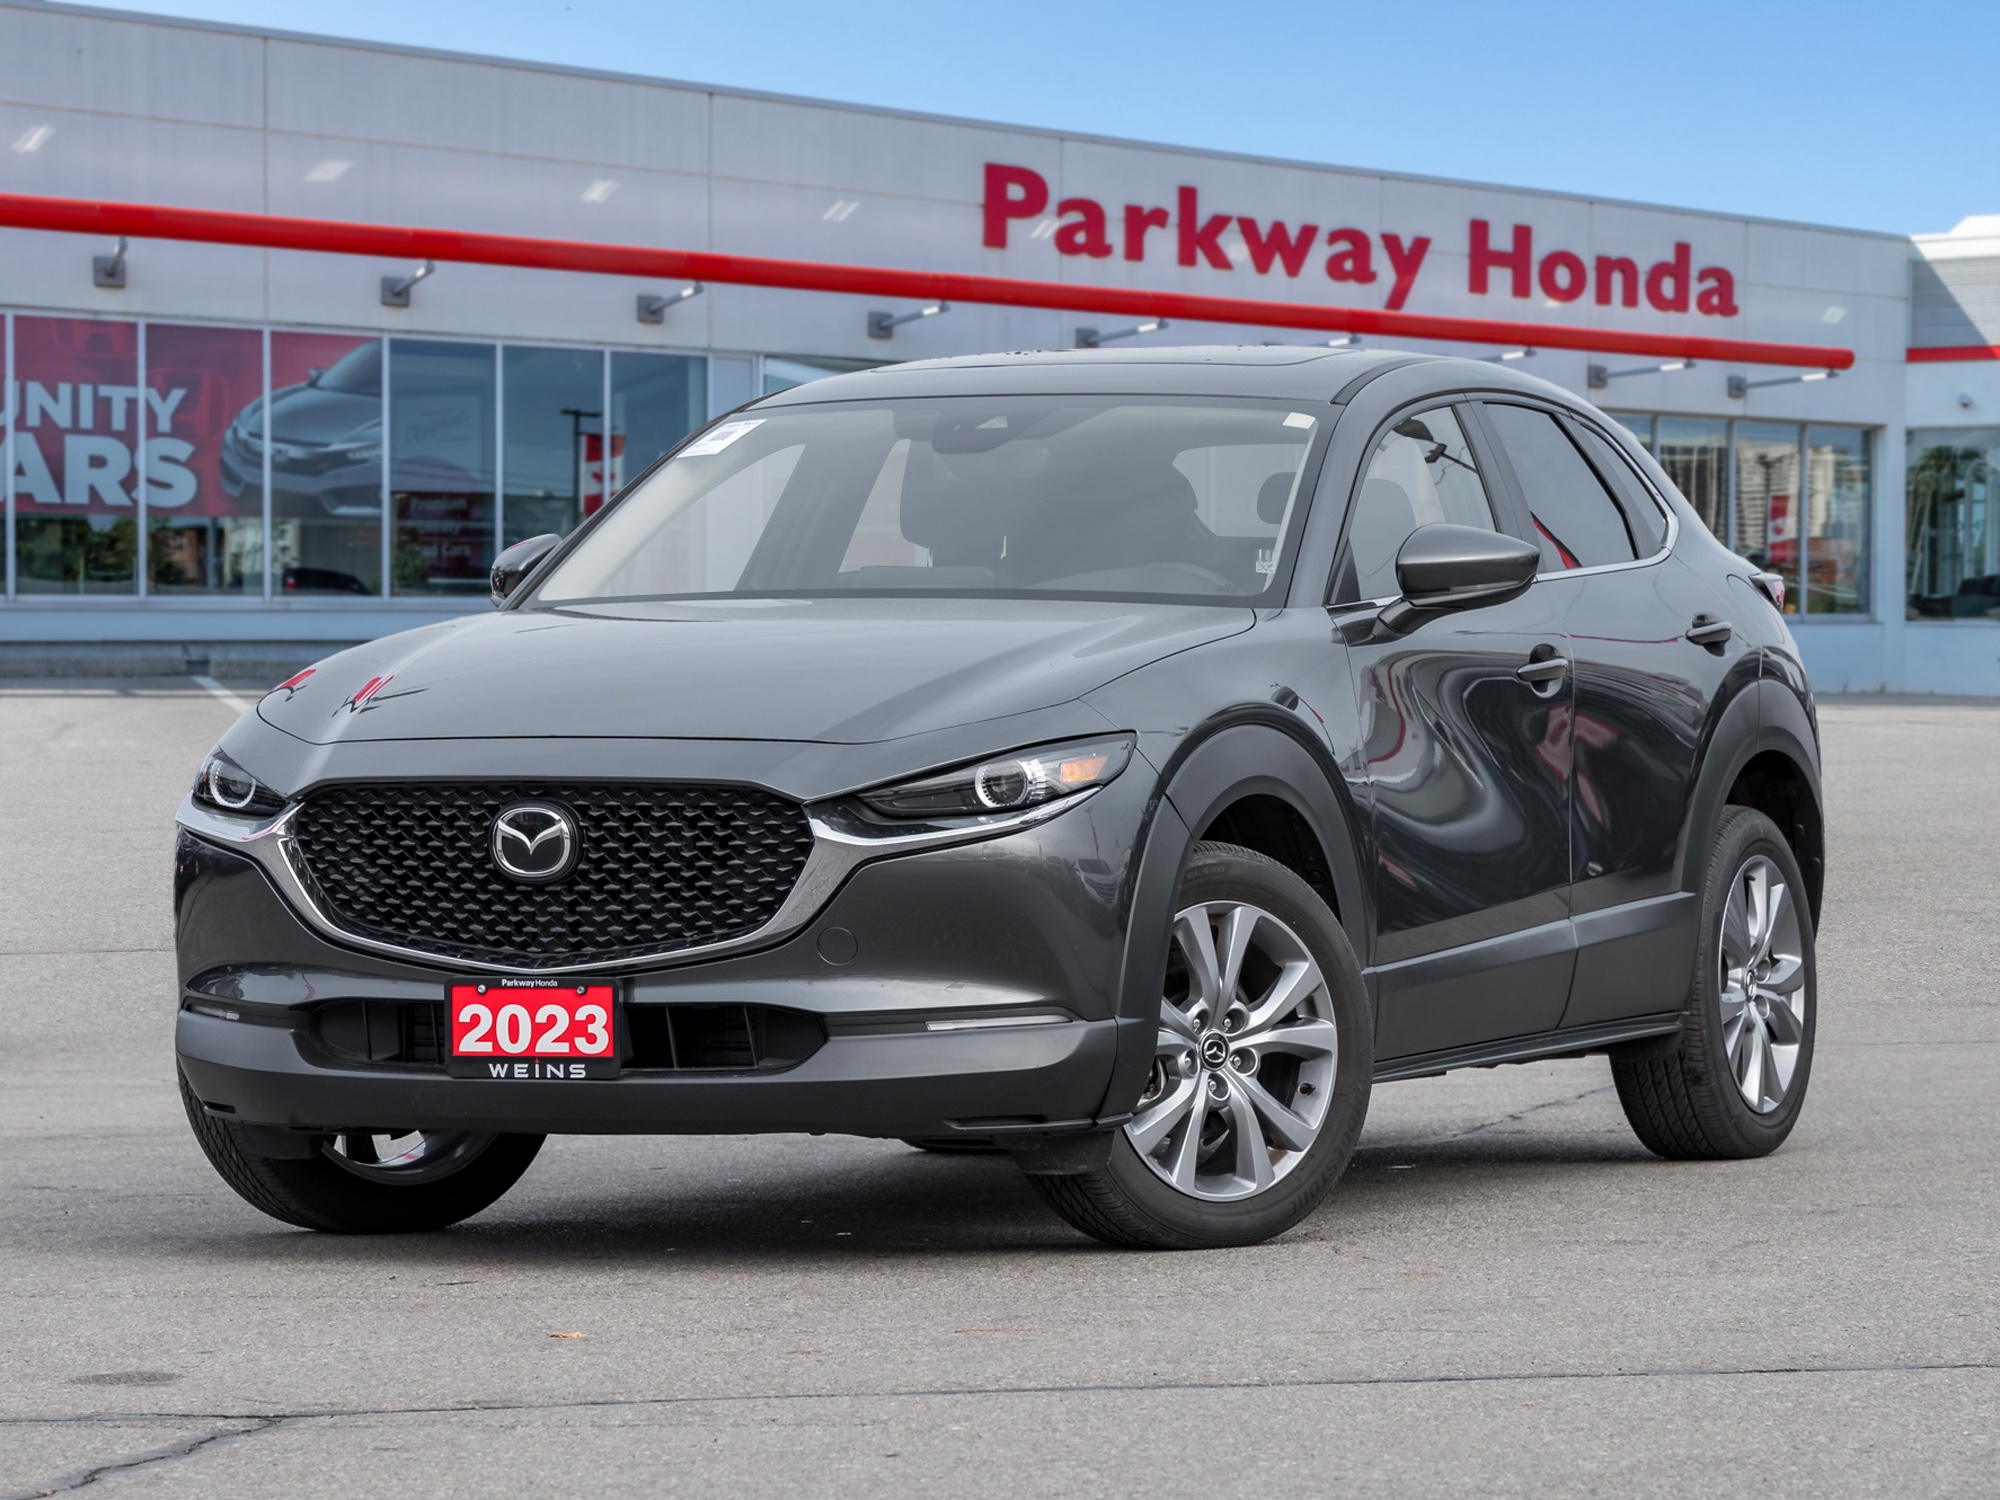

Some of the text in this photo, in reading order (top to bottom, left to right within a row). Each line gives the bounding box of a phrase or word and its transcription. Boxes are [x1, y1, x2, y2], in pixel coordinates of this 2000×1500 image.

[983, 163, 1739, 316] Parkway Honda
[502, 979, 558, 988] Parkway Honda
[458, 1003, 609, 1055] 2023
[488, 1062, 586, 1079] WEINS
